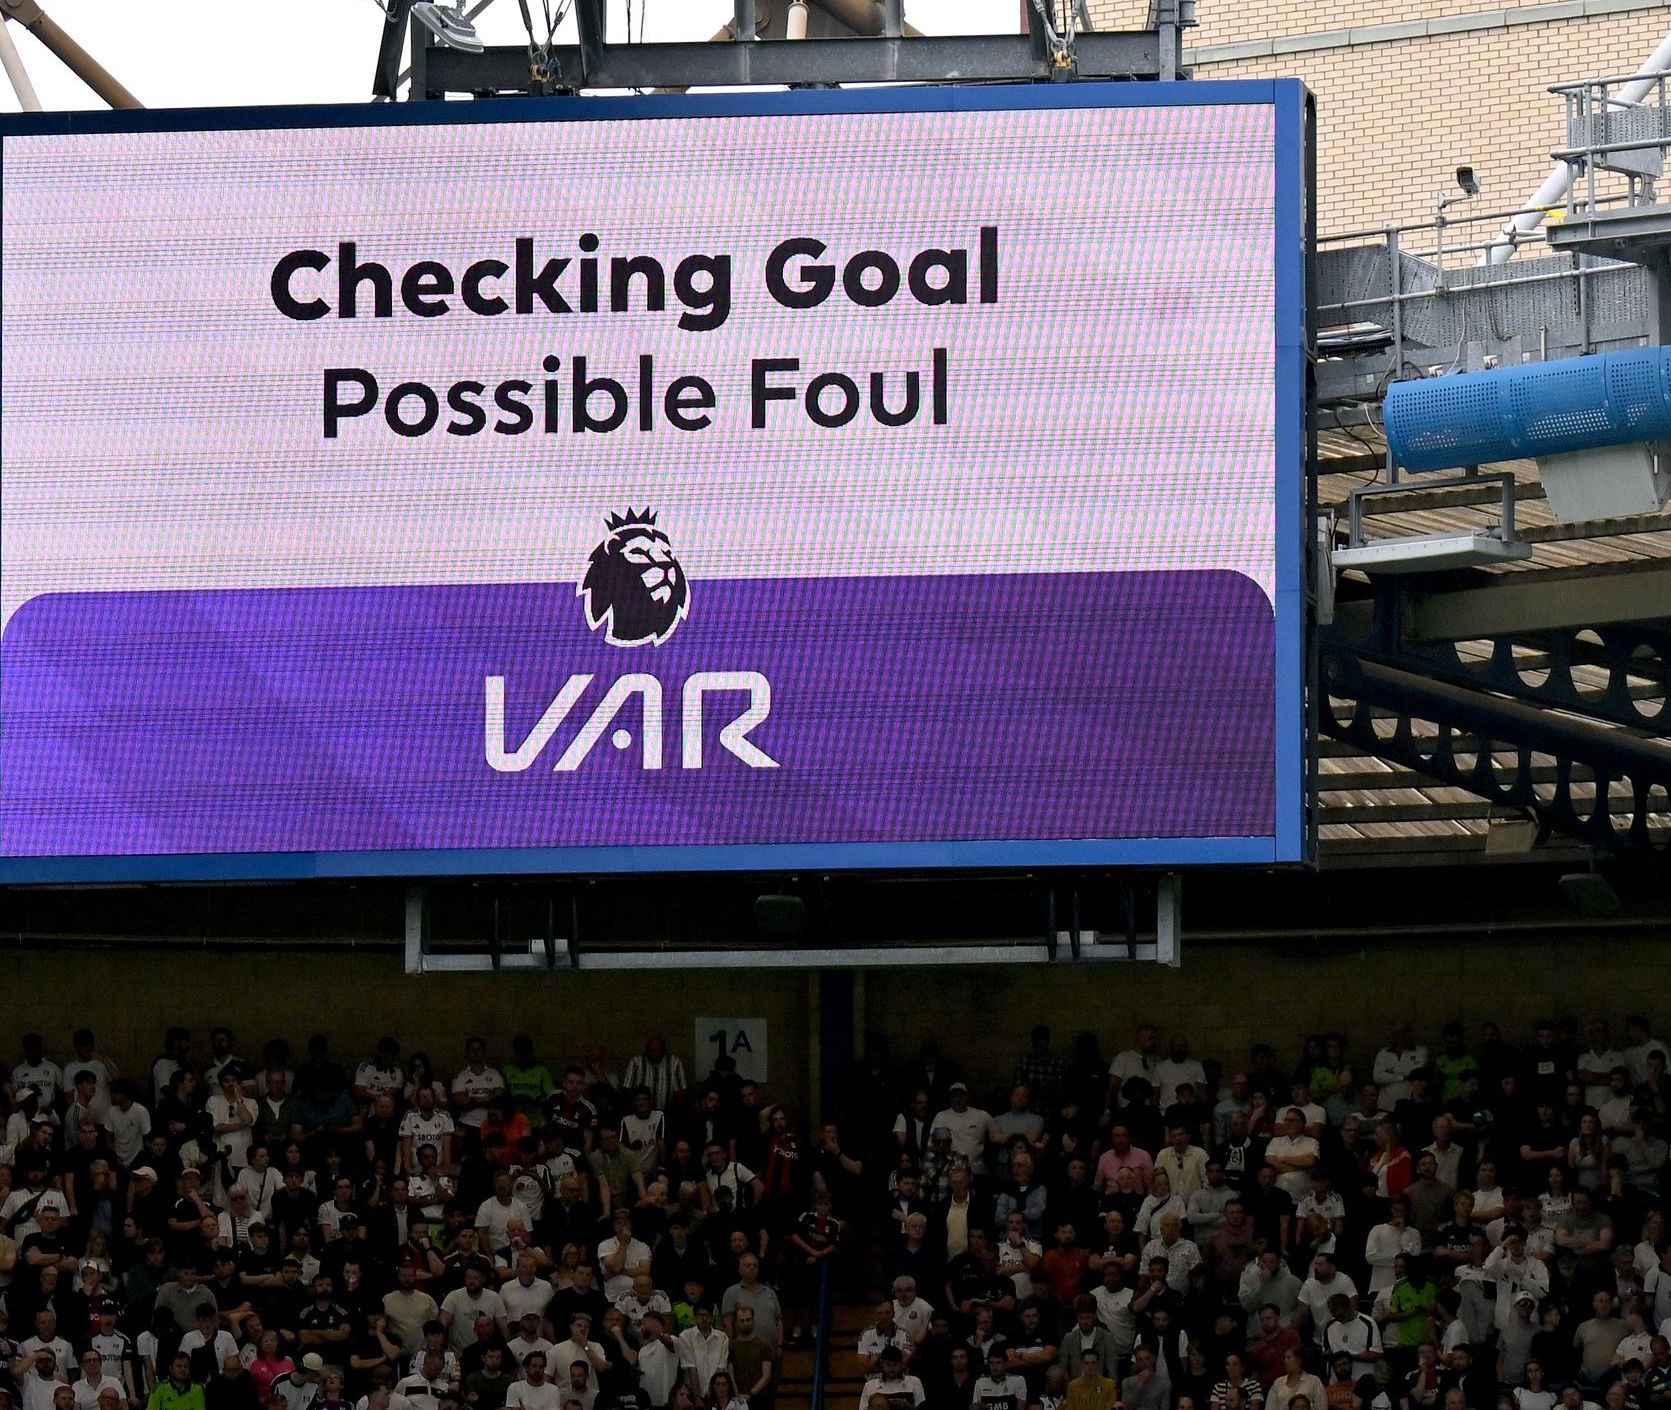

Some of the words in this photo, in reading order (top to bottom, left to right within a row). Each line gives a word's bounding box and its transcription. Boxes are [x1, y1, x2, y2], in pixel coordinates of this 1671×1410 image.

[271, 233, 731, 332] Checking
[764, 226, 999, 310] Goal
[323, 354, 717, 438] Possible
[751, 347, 948, 430] Foul
[485, 671, 781, 772] VAR
